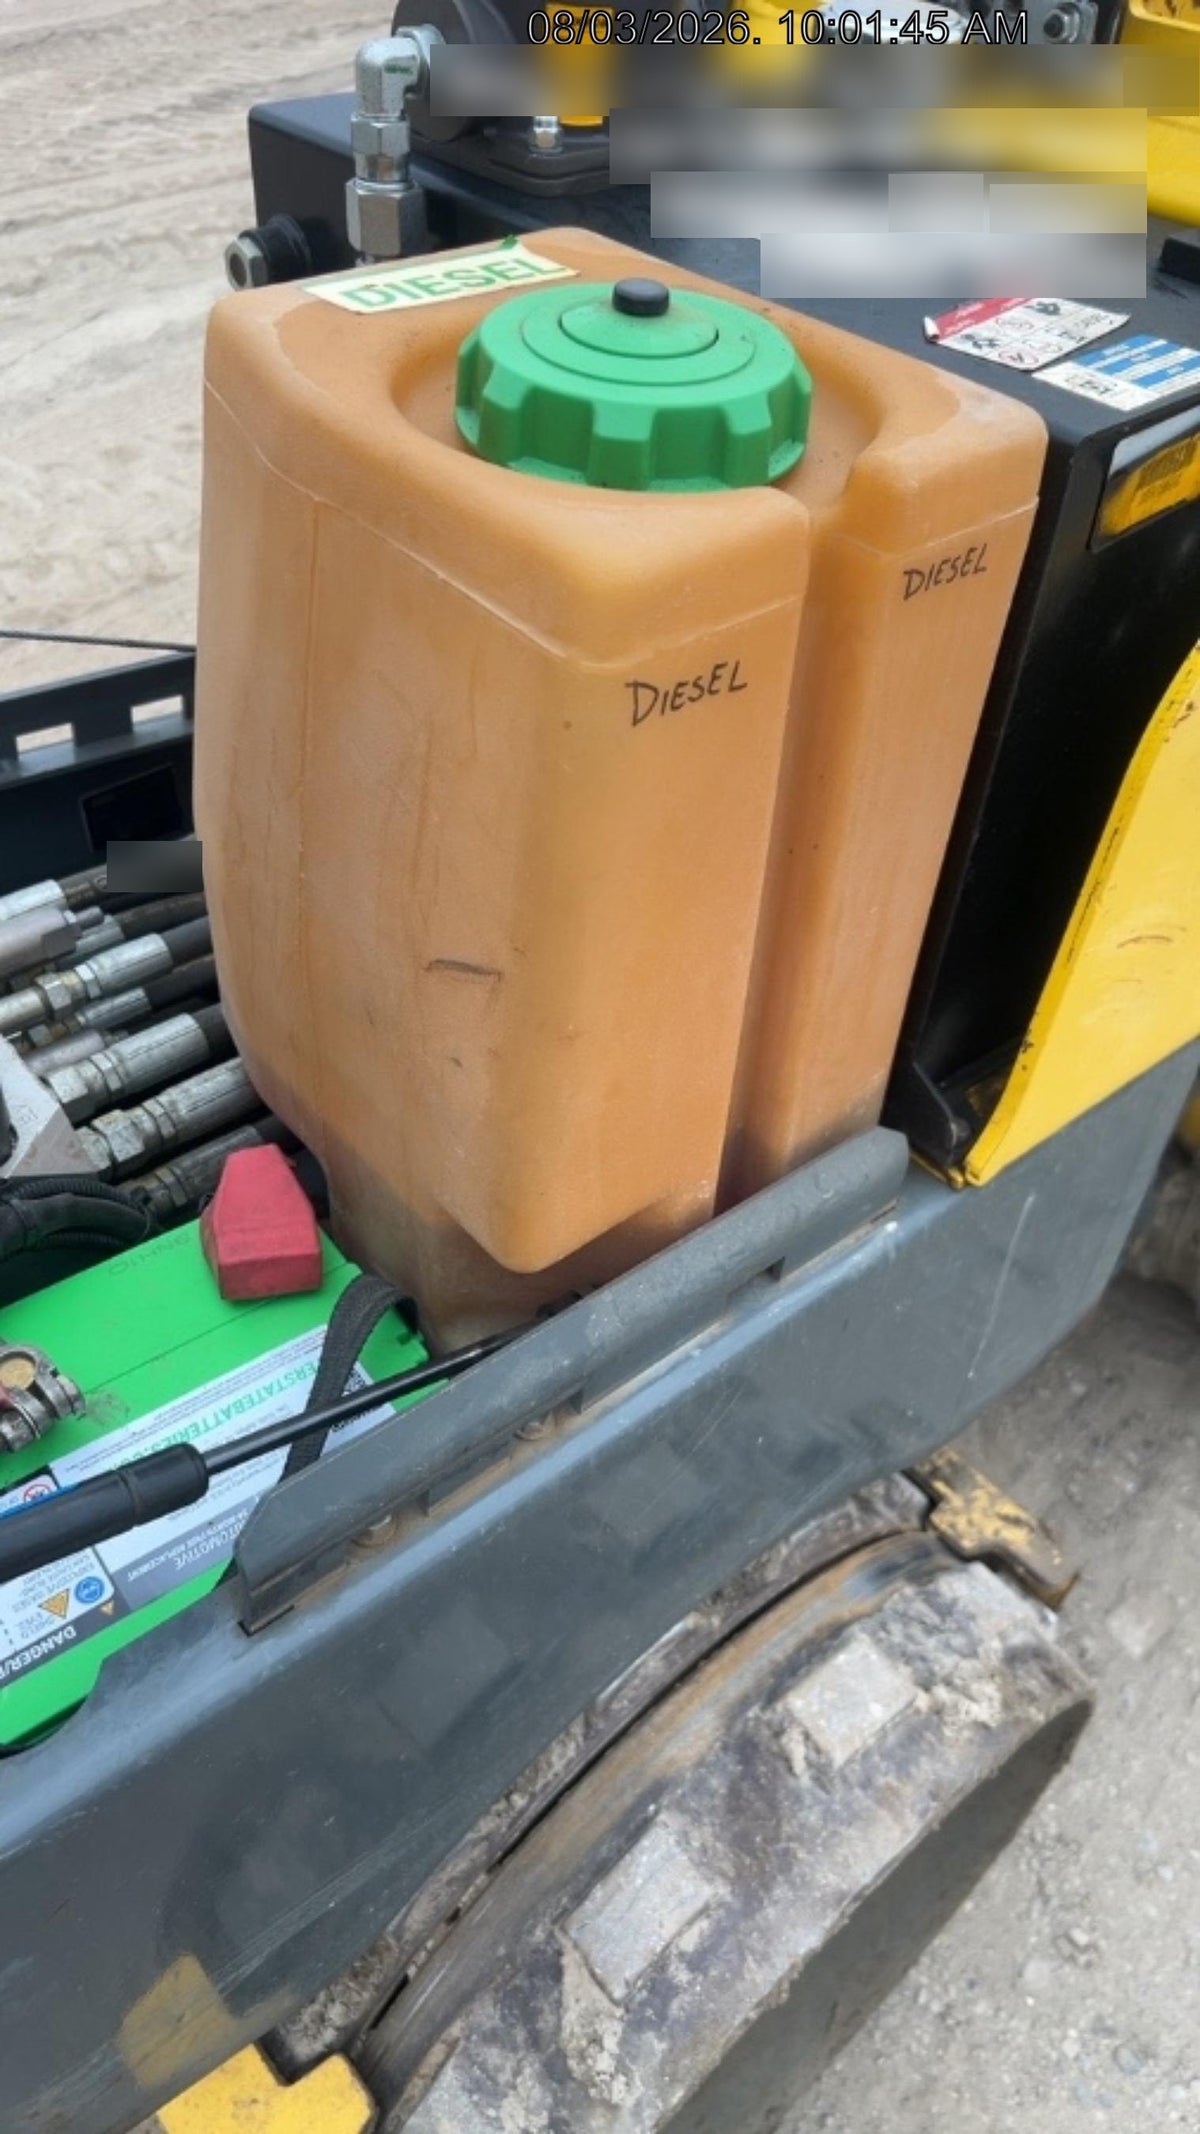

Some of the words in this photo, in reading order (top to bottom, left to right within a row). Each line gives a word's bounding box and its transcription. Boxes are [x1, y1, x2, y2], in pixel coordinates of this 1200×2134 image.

[340, 258, 568, 307] DIESEL
[903, 543, 988, 600] DIESEL
[625, 660, 748, 727] DIESEL
[175, 1519, 245, 1569] UTOMOTIVE
